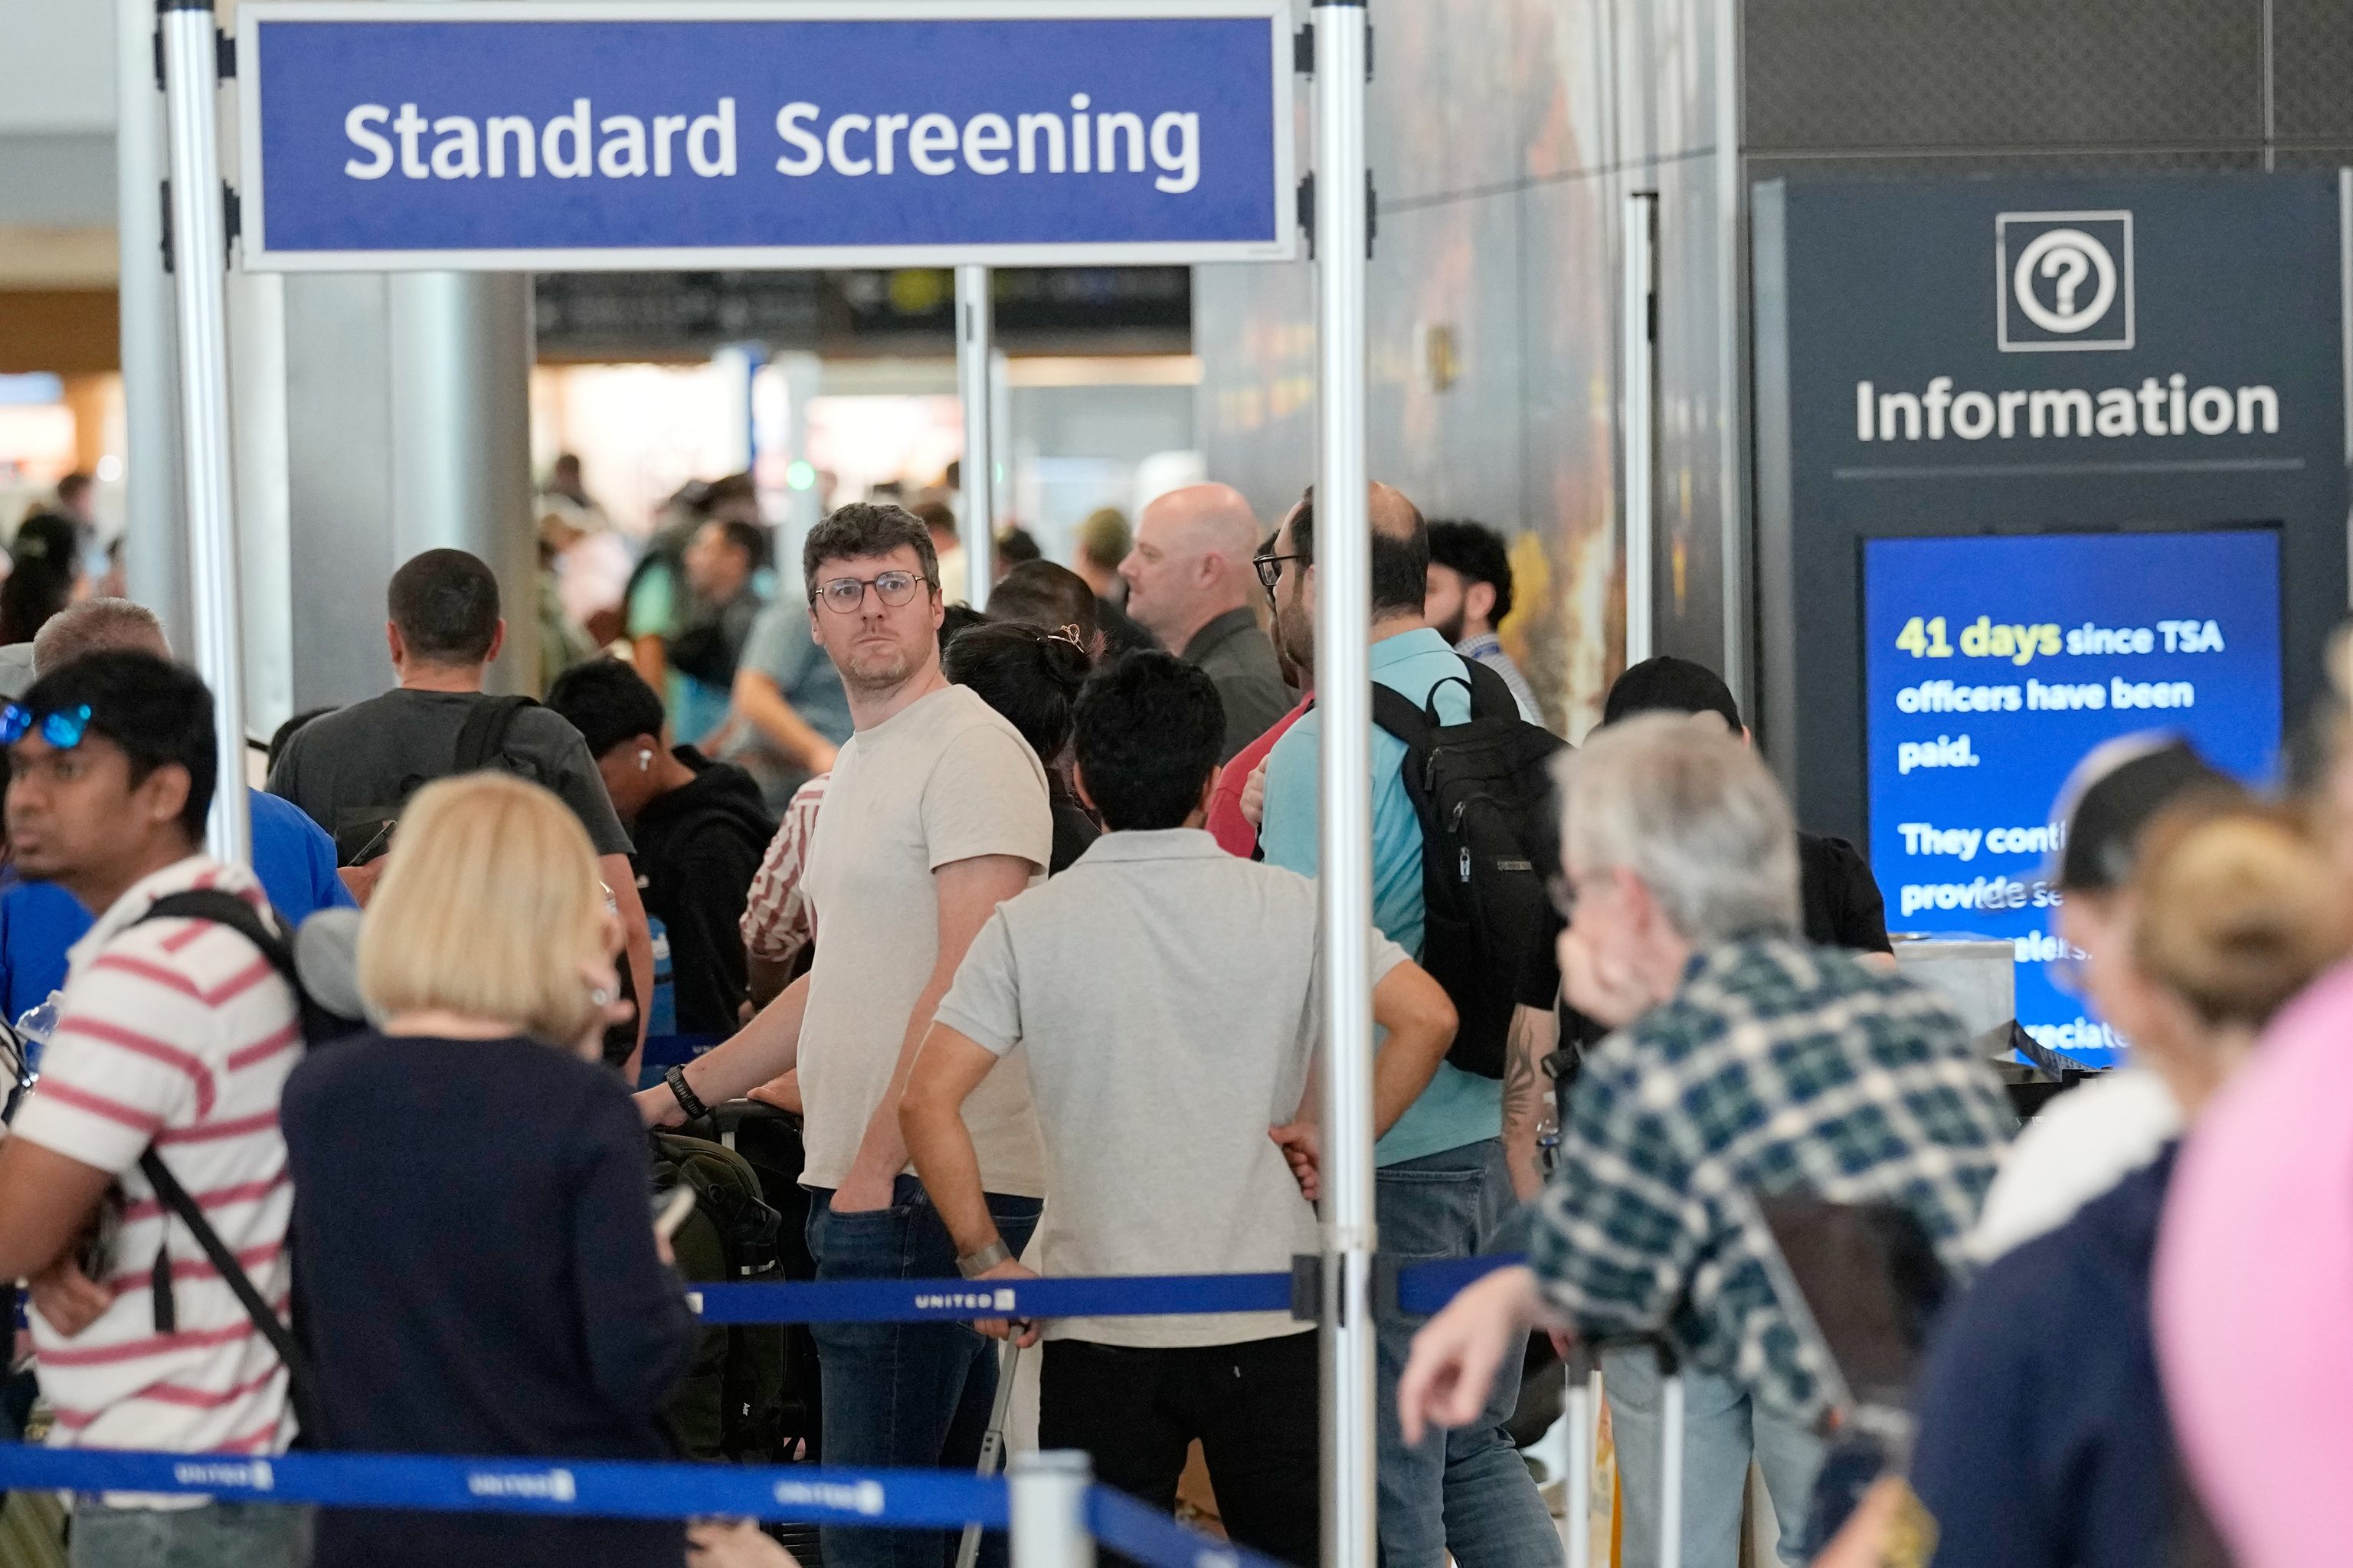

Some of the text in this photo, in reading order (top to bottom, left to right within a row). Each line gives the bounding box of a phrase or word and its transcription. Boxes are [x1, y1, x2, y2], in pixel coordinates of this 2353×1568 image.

[344, 93, 1200, 195] Standard Screening
[1856, 373, 2279, 442] Information
[1895, 615, 2225, 666] 41 days since TSA
[1895, 675, 2195, 714] officers have been
[1897, 733, 1982, 776] paid.
[1896, 822, 1984, 862] They
[1900, 875, 2028, 918] provide
[915, 1293, 993, 1310] UNITED
[742, 1402, 751, 1416] Aer
